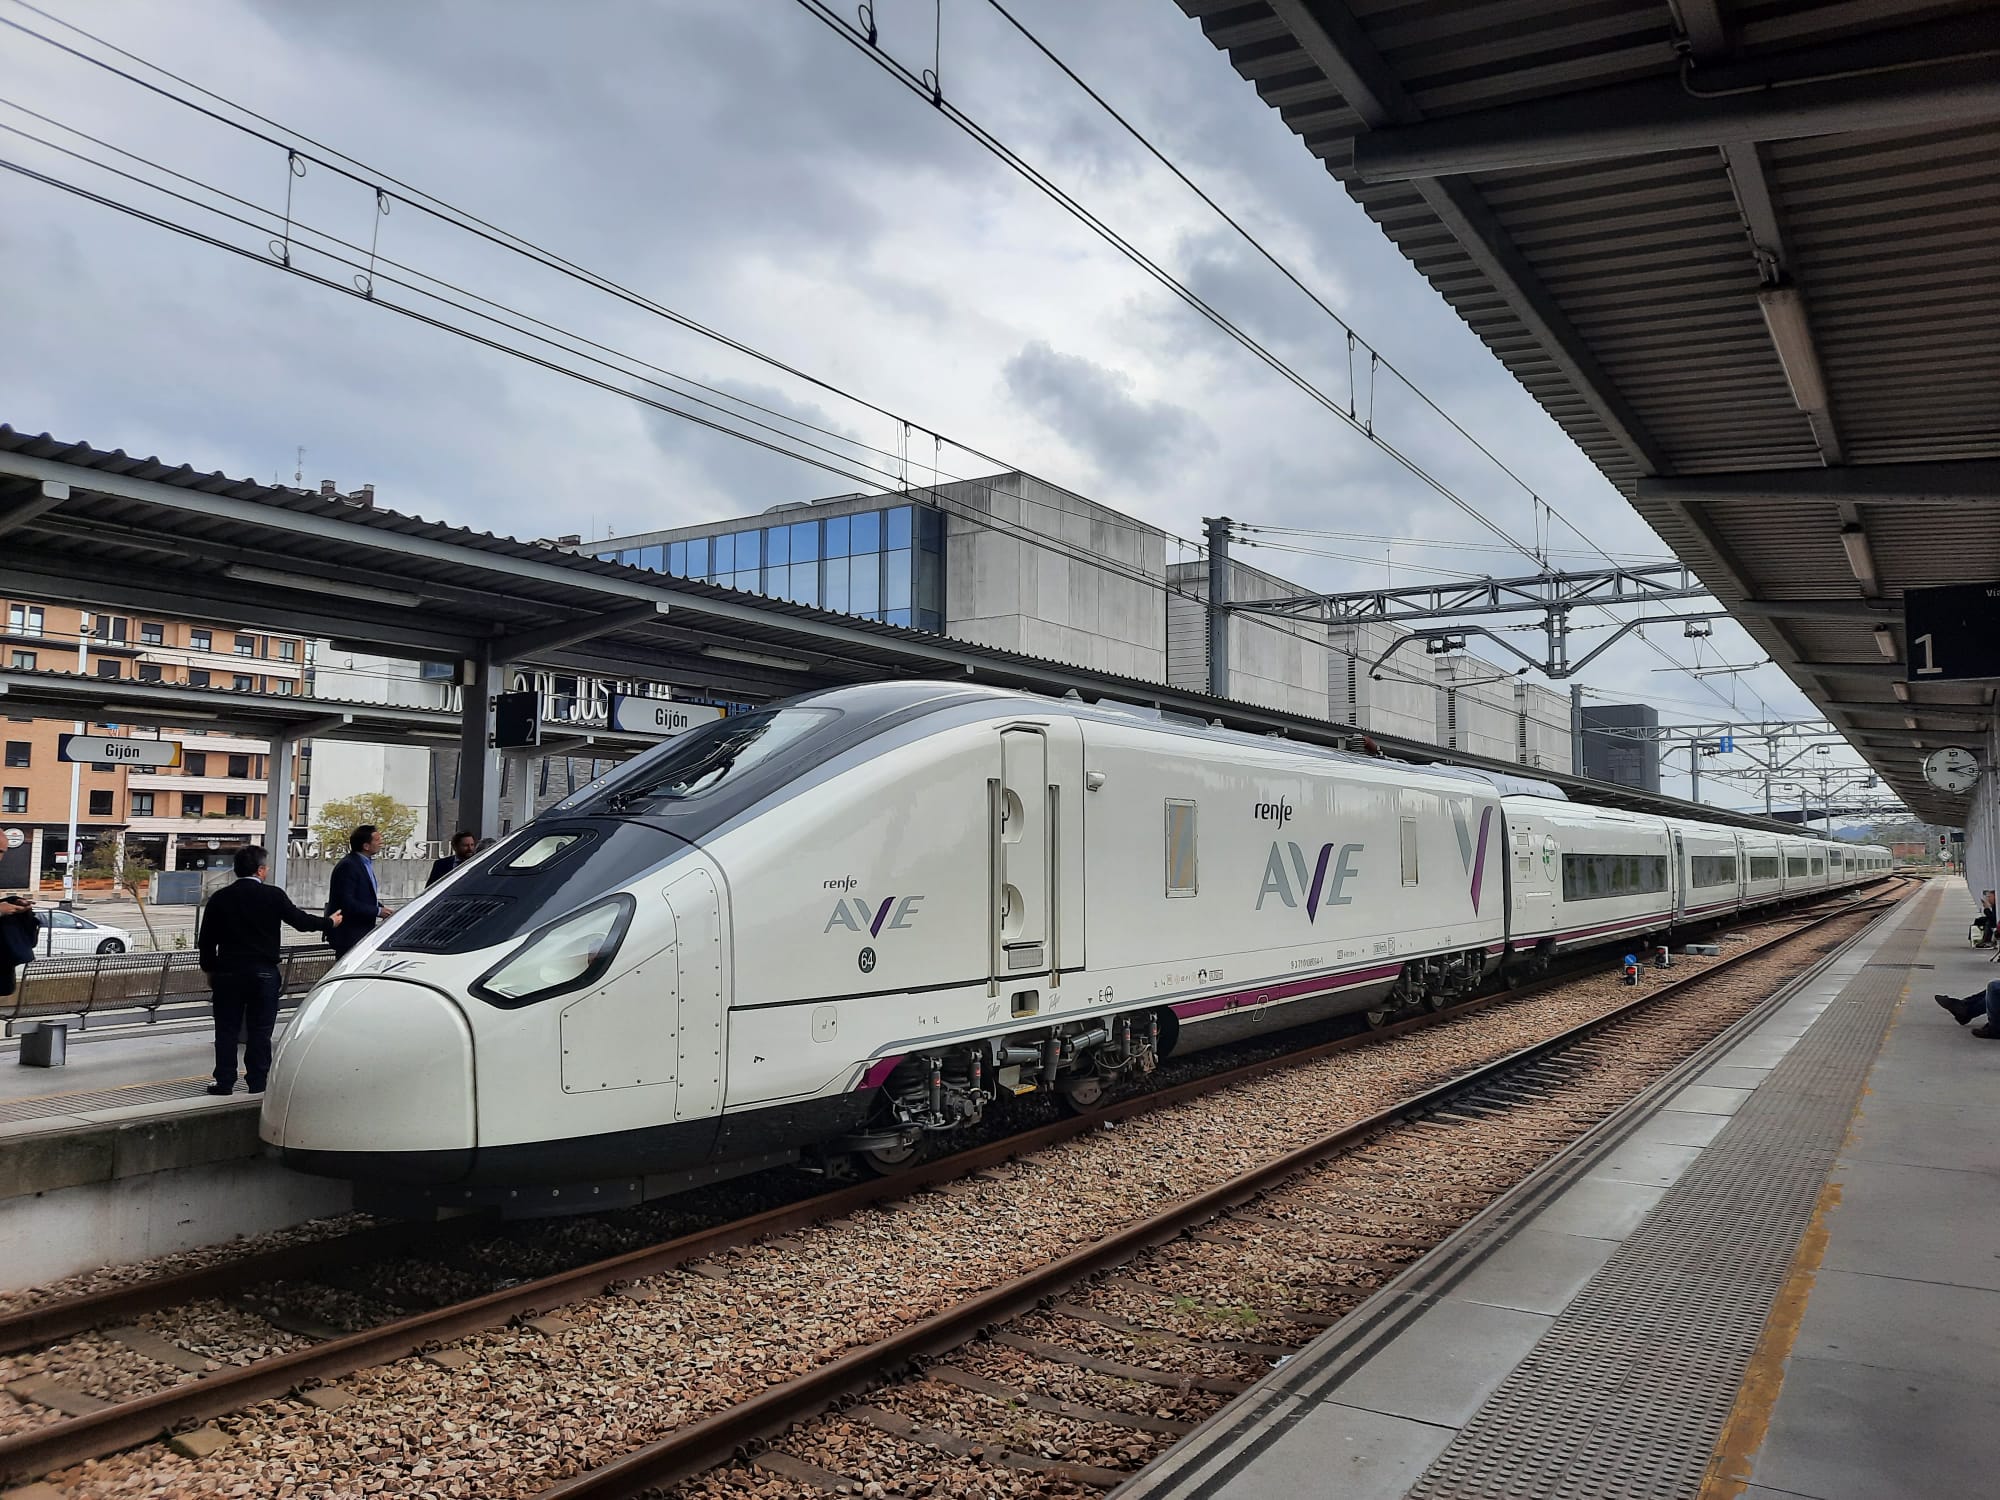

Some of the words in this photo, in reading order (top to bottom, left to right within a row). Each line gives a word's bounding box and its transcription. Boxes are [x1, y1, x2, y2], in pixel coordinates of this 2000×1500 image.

[1915, 633, 1943, 675] 1
[525, 718, 535, 742] 2
[655, 708, 688, 730] Gijón
[105, 743, 140, 760] Gijón
[1254, 794, 1293, 830] renfe
[823, 875, 858, 893] renfe
[1255, 841, 1365, 926] AVE
[823, 895, 925, 939] AVE
[860, 952, 874, 969] 64
